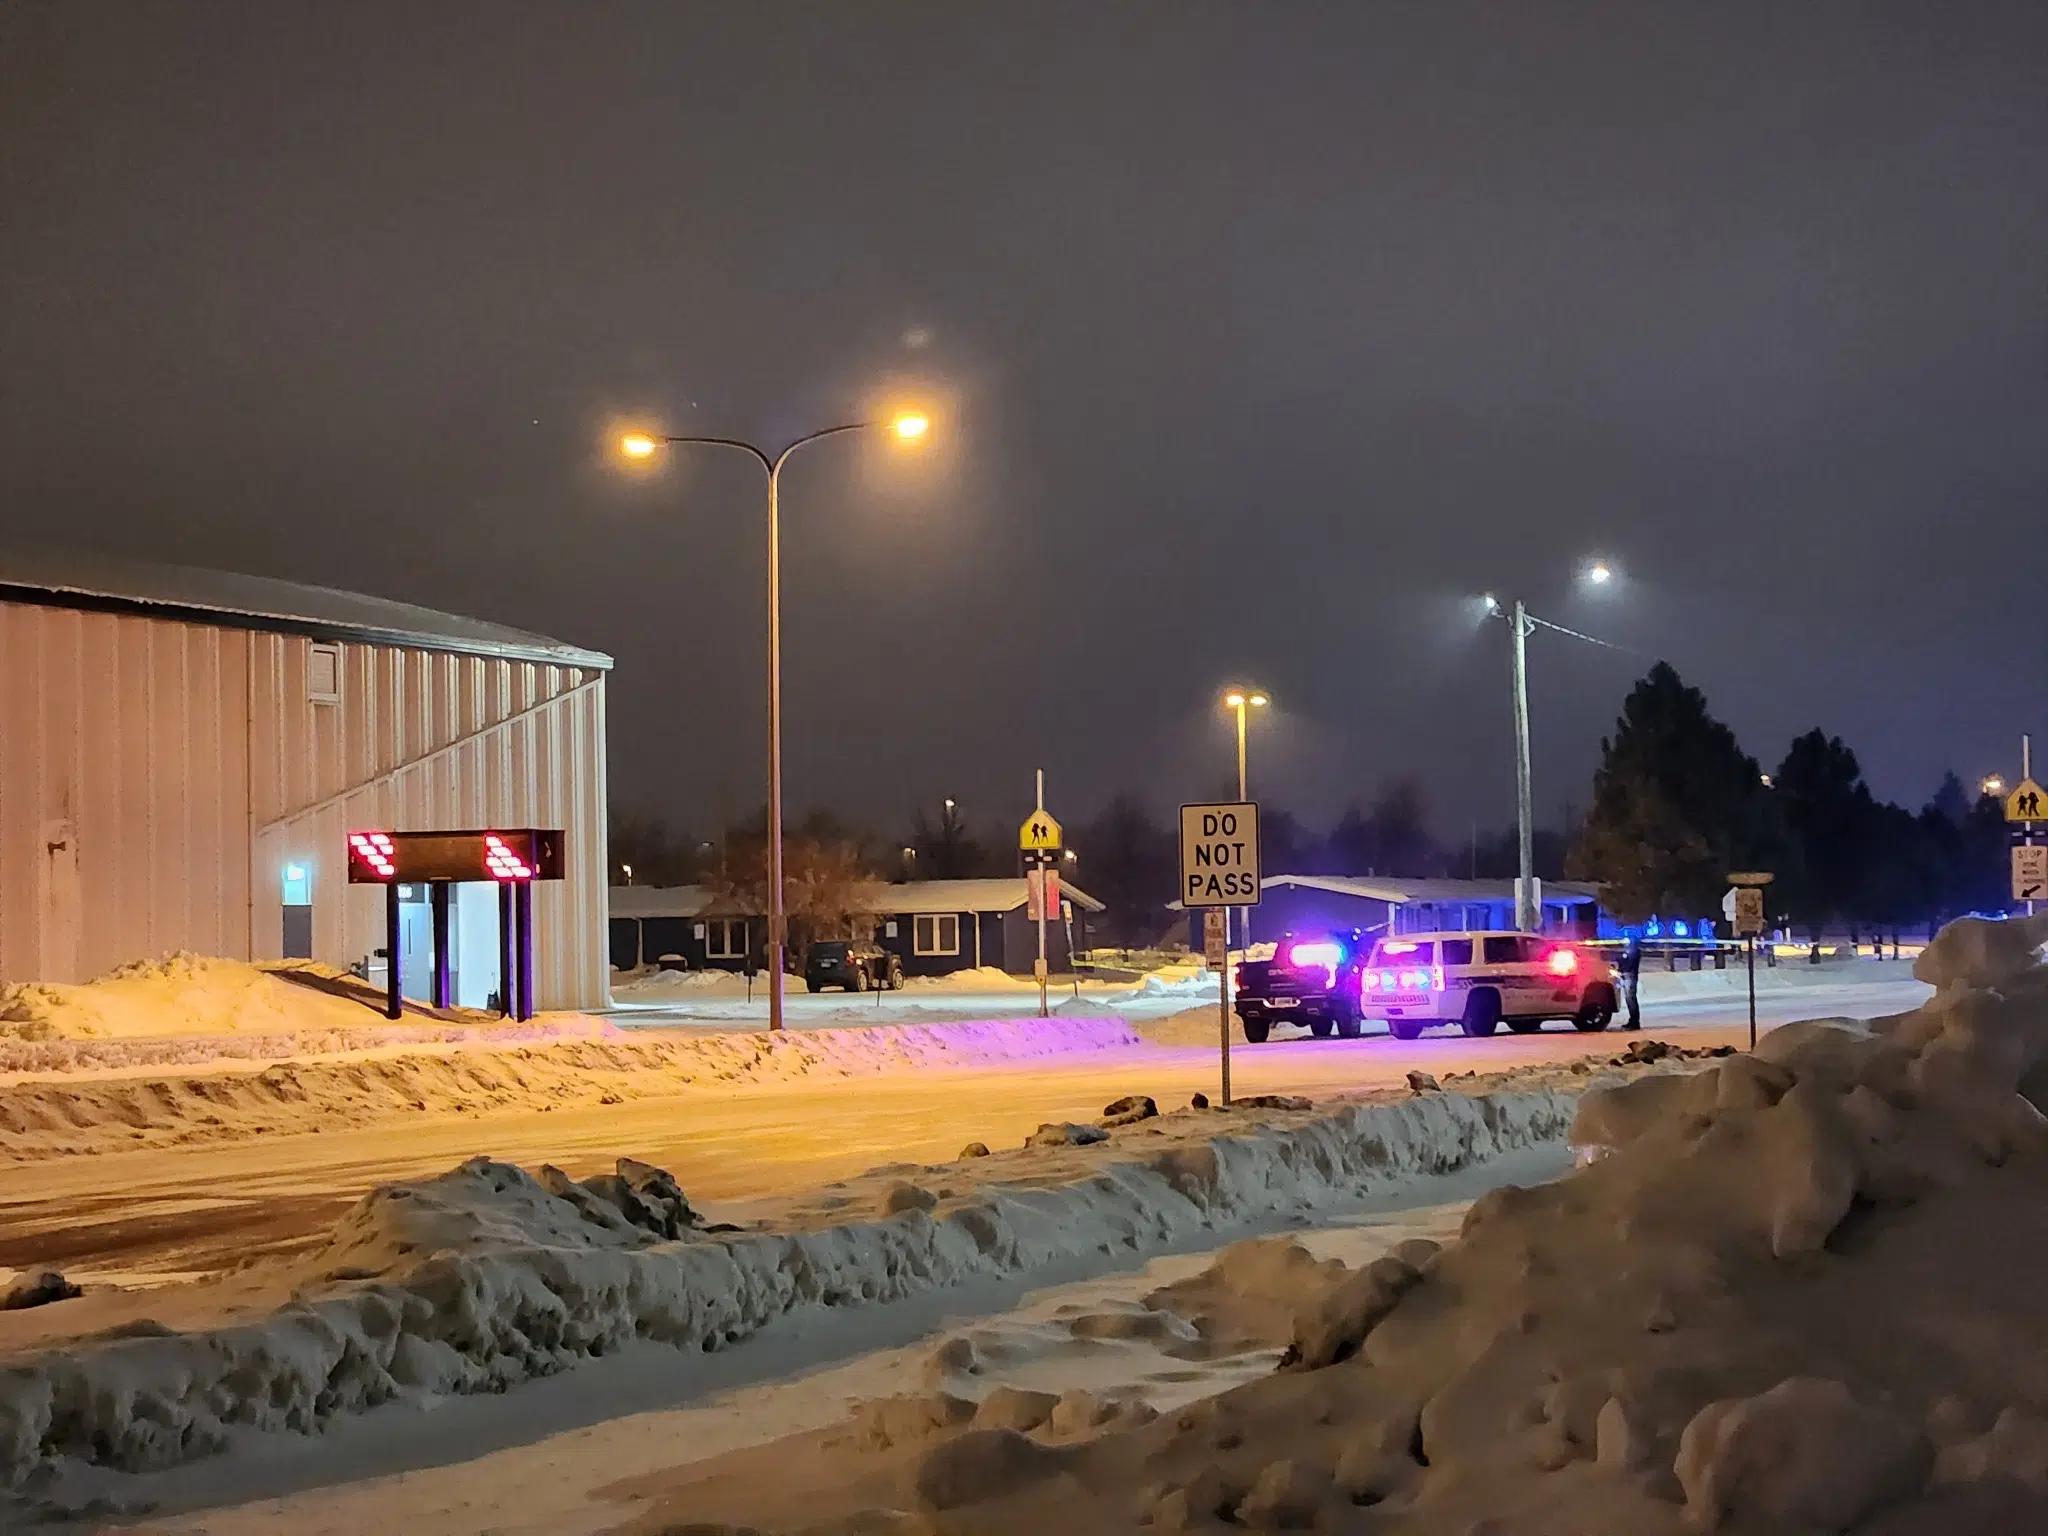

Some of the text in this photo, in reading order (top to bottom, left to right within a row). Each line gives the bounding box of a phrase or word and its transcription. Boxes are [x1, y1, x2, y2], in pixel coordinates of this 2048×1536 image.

[1203, 813, 1237, 837] DO
[1195, 843, 1245, 867] NOT
[2017, 849, 2043, 859] STOP
[1188, 873, 1254, 899] PASS
